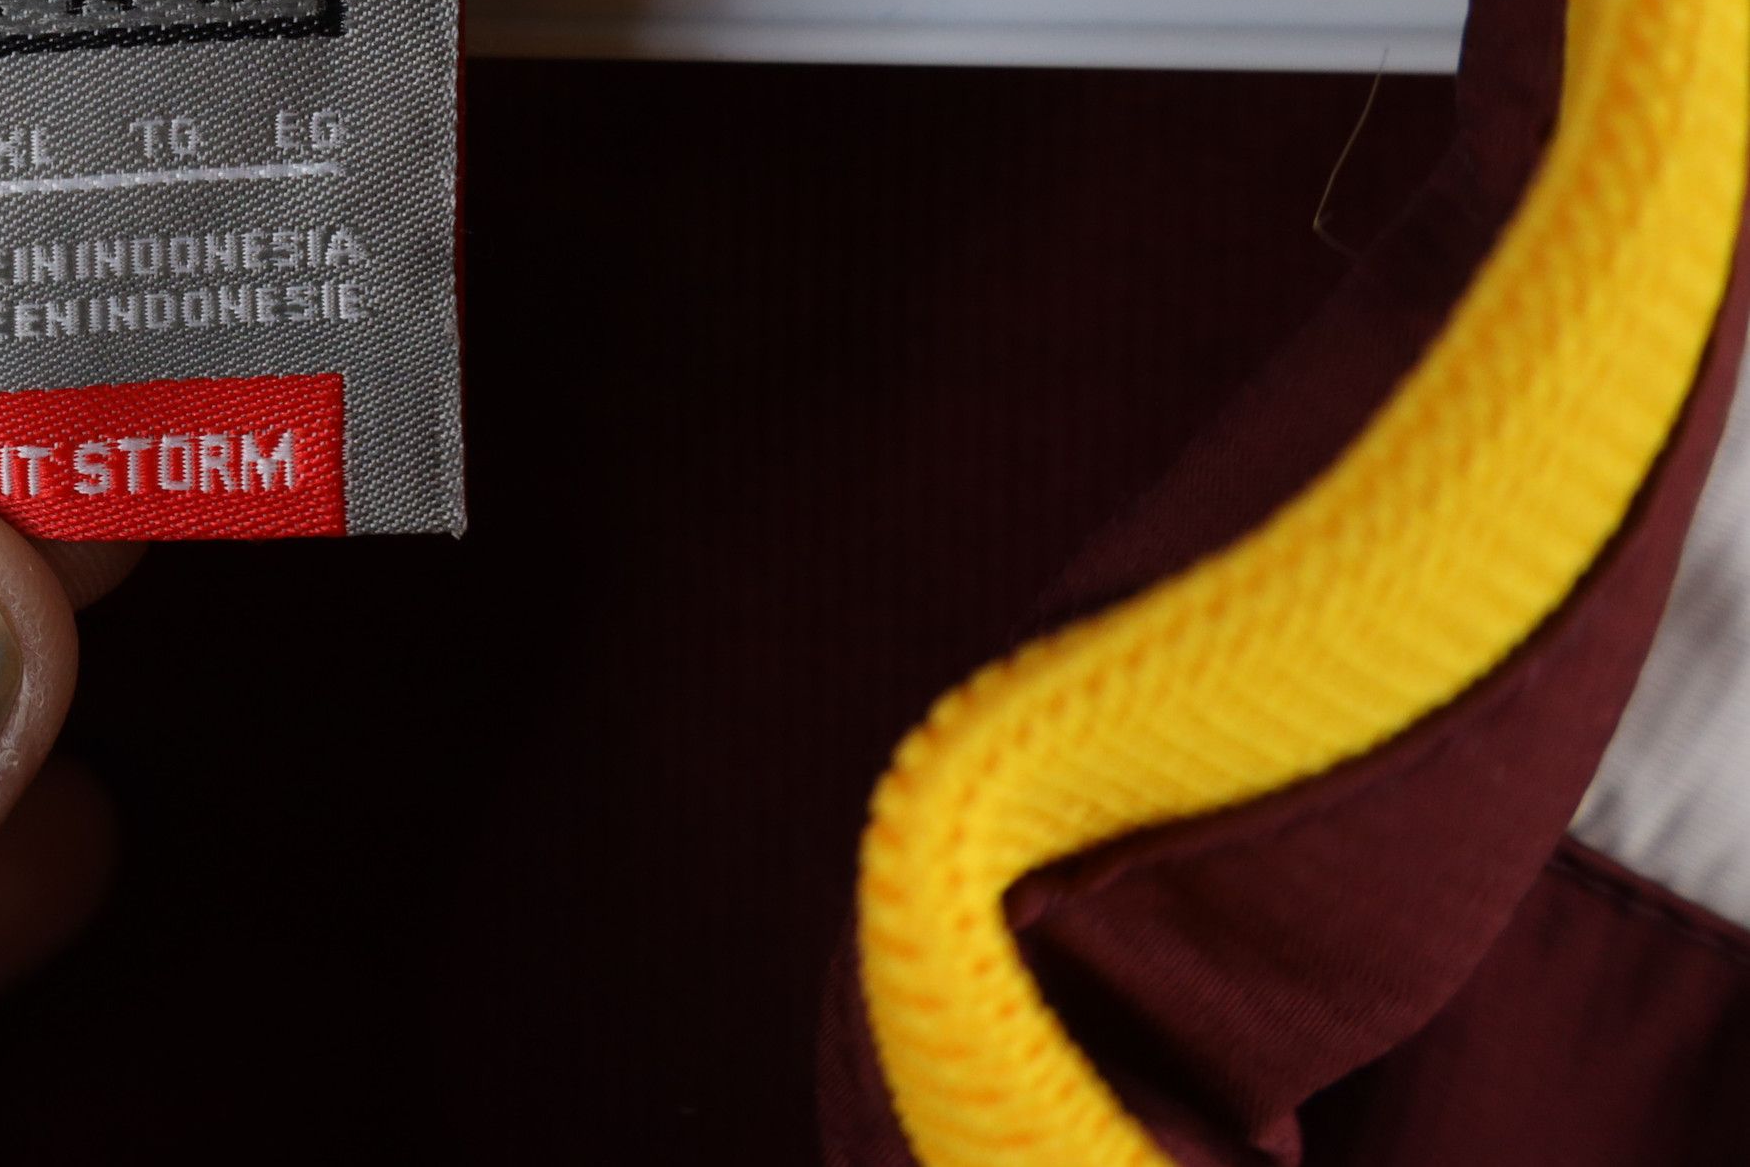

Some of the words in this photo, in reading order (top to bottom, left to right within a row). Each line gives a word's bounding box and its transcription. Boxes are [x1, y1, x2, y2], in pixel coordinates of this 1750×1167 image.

[130, 116, 199, 158] TG
[276, 109, 350, 150] EG
[13, 241, 68, 283] IN
[76, 225, 368, 279] INDONESIA
[15, 298, 80, 337] EN
[88, 281, 364, 334] INDONESIE
[73, 431, 297, 496] STORM
